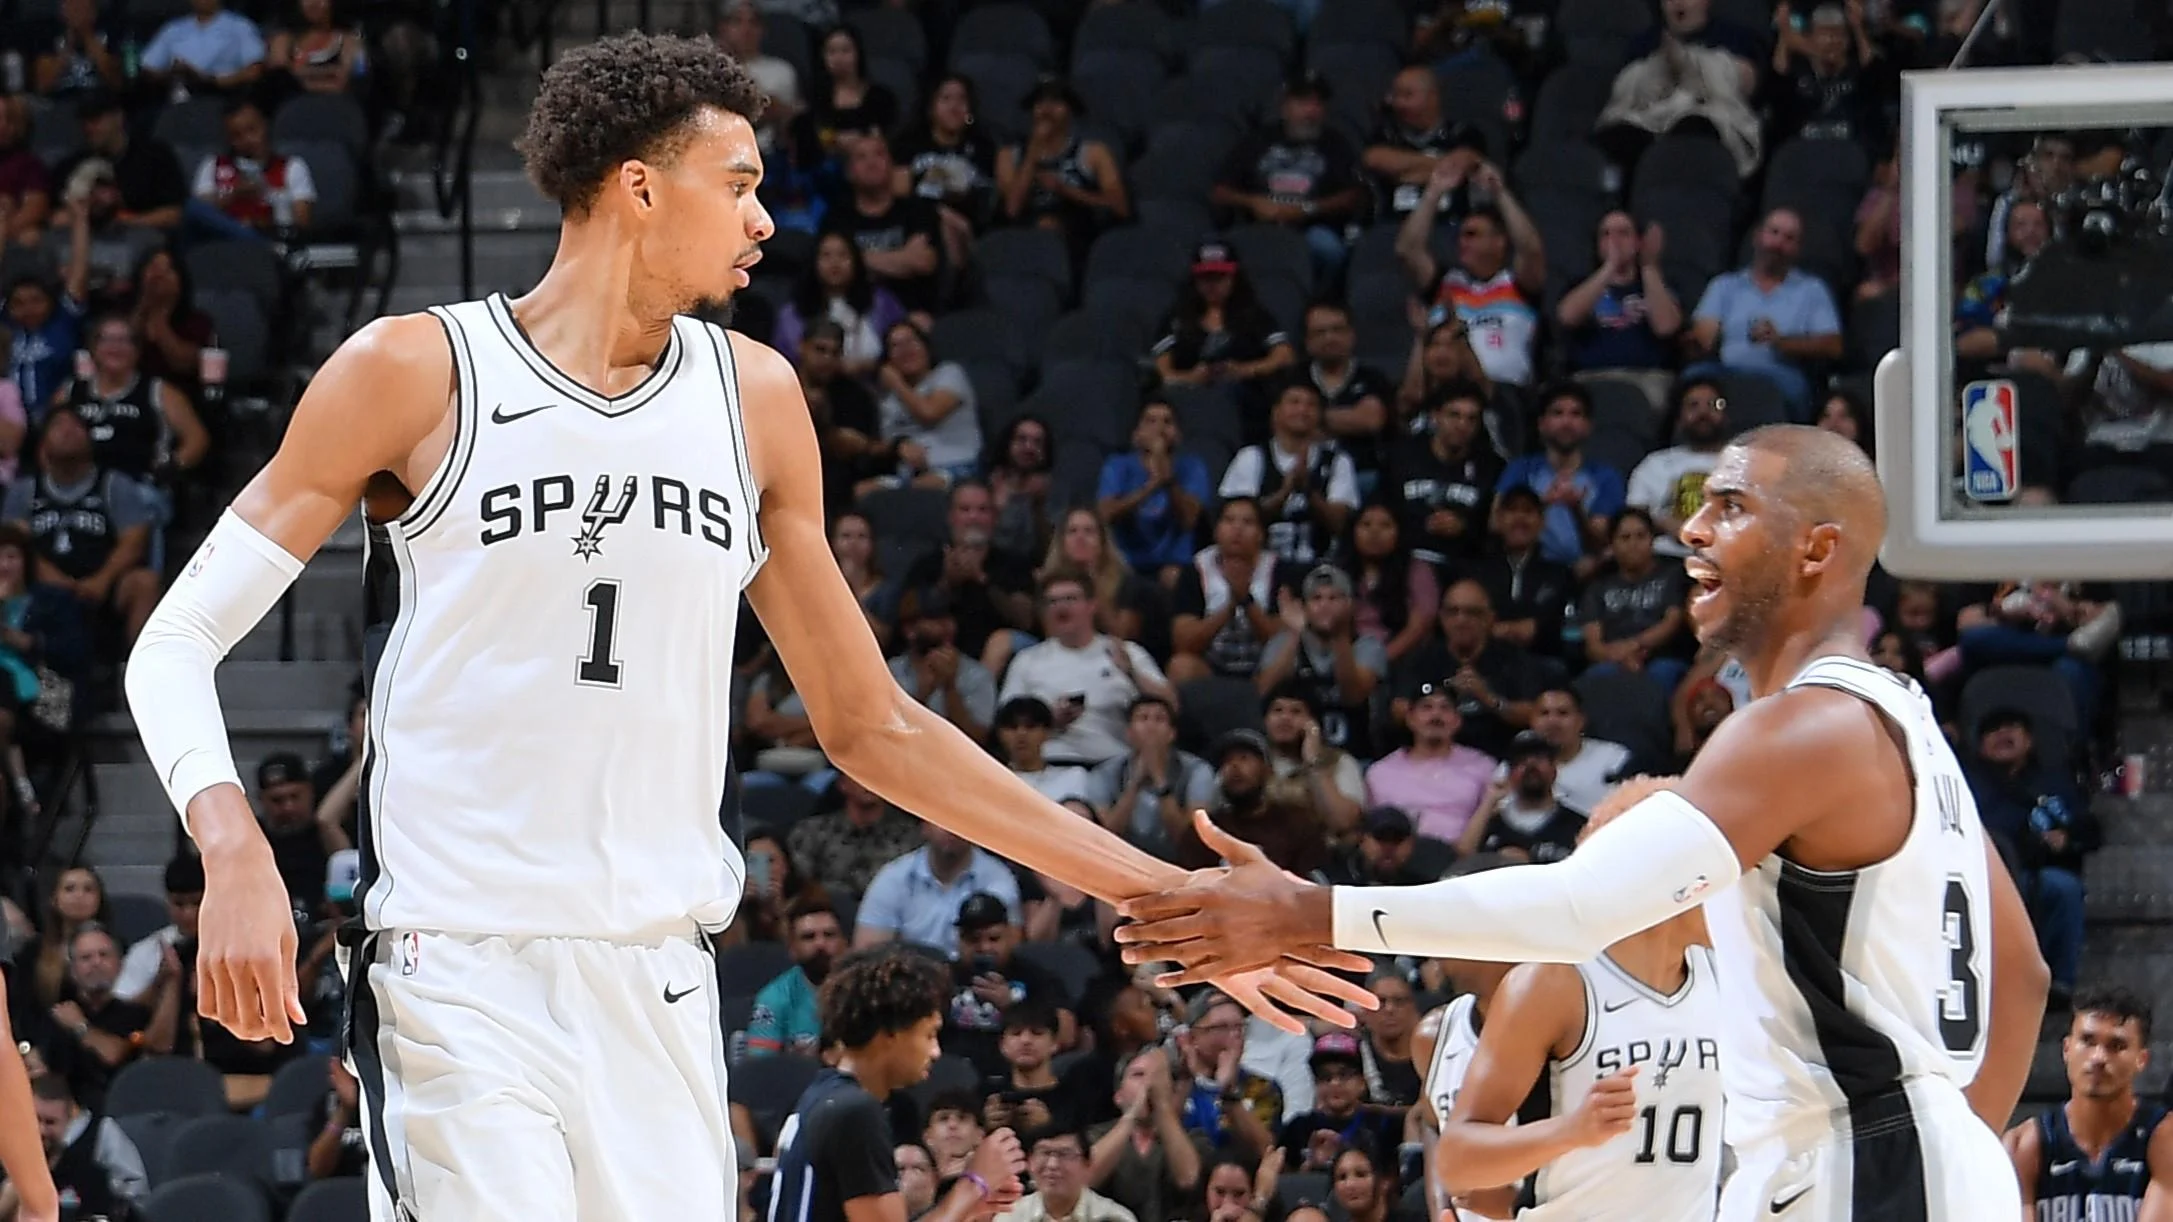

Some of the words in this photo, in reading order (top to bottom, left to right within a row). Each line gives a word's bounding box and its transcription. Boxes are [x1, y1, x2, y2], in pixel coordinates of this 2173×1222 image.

[1972, 472, 1999, 494] NBA
[480, 474, 732, 564] SPURS
[575, 578, 624, 690] 1
[1936, 872, 1985, 1059] 3
[1596, 1038, 1720, 1091] SPUR
[1632, 1103, 1706, 1166] 10
[2035, 1194, 2147, 1222] ORLAND
